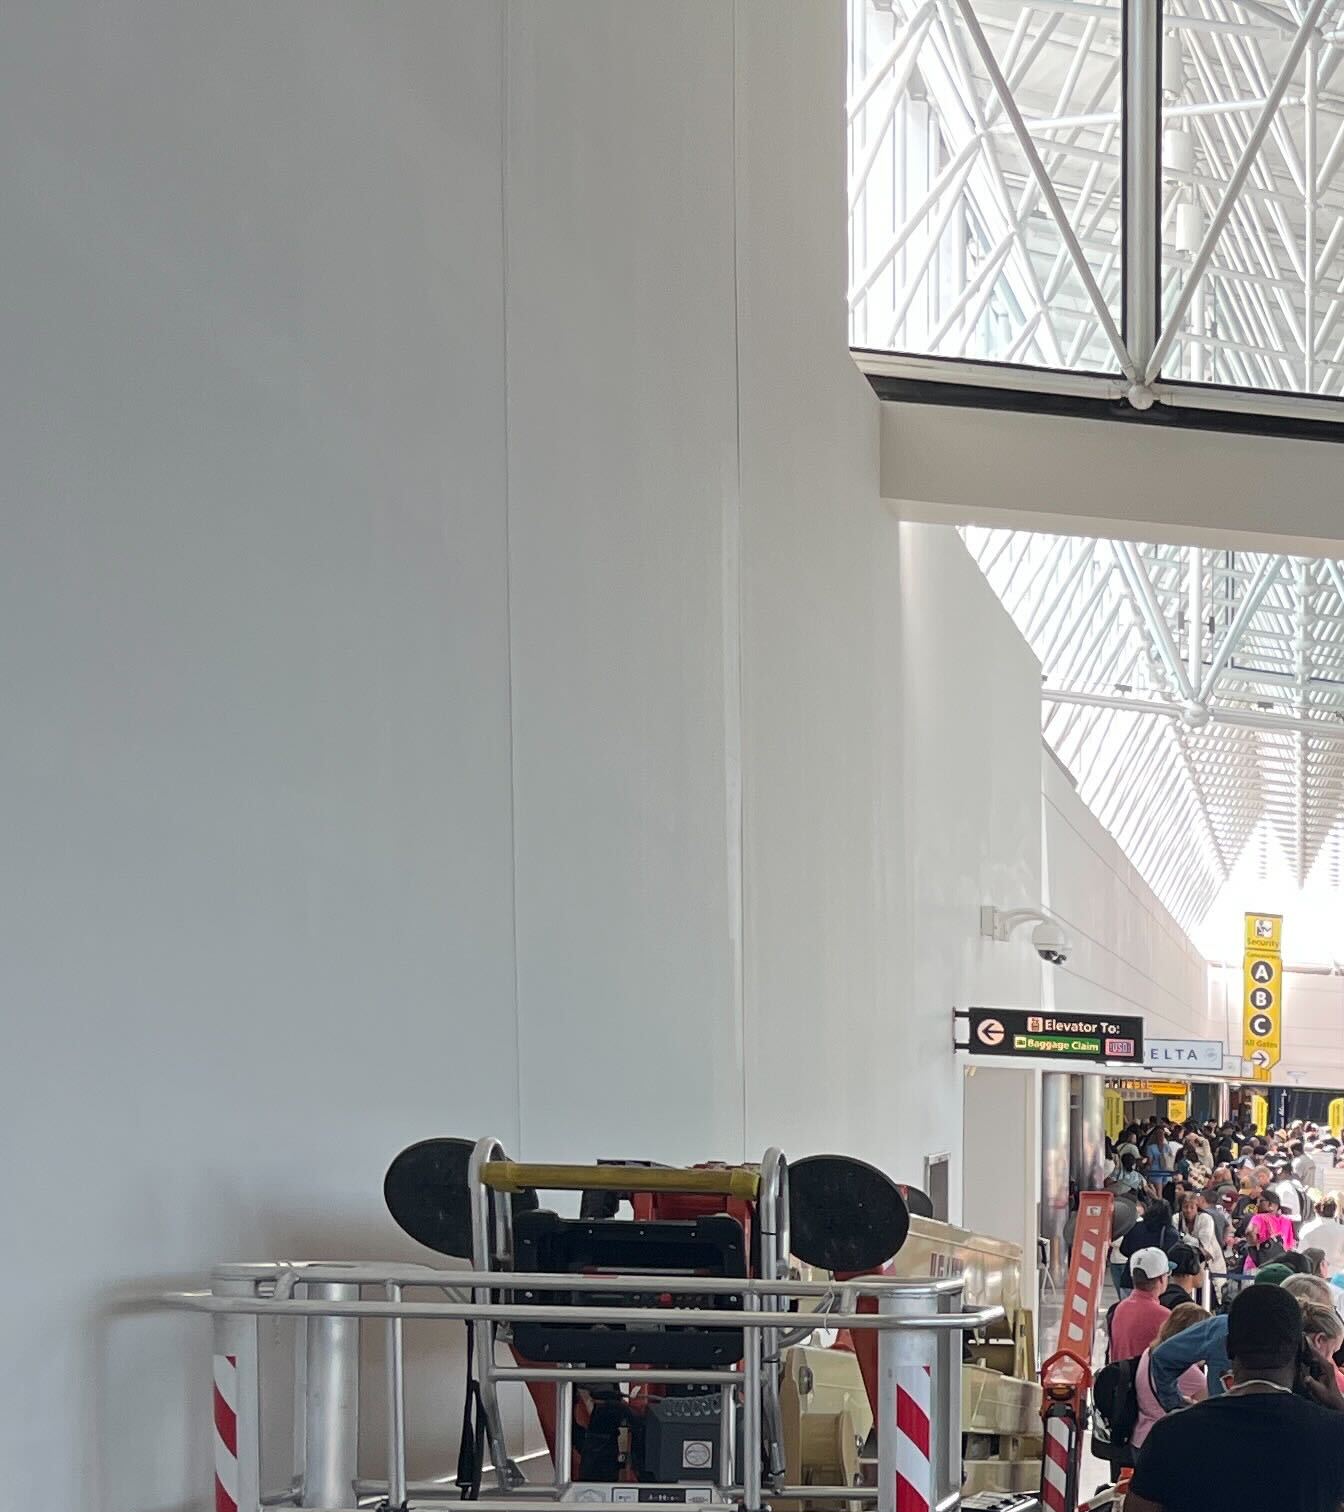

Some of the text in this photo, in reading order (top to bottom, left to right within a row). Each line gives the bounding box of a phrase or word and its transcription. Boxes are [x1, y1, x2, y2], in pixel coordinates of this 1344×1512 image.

[1247, 938, 1279, 948] Security
[1255, 964, 1269, 980] A
[1255, 991, 1267, 1006] B
[1045, 1020, 1121, 1035] Elevator To:
[1254, 1018, 1266, 1033] C
[1028, 1039, 1099, 1051] Baggage Claim
[1149, 1047, 1199, 1061] ELTA
